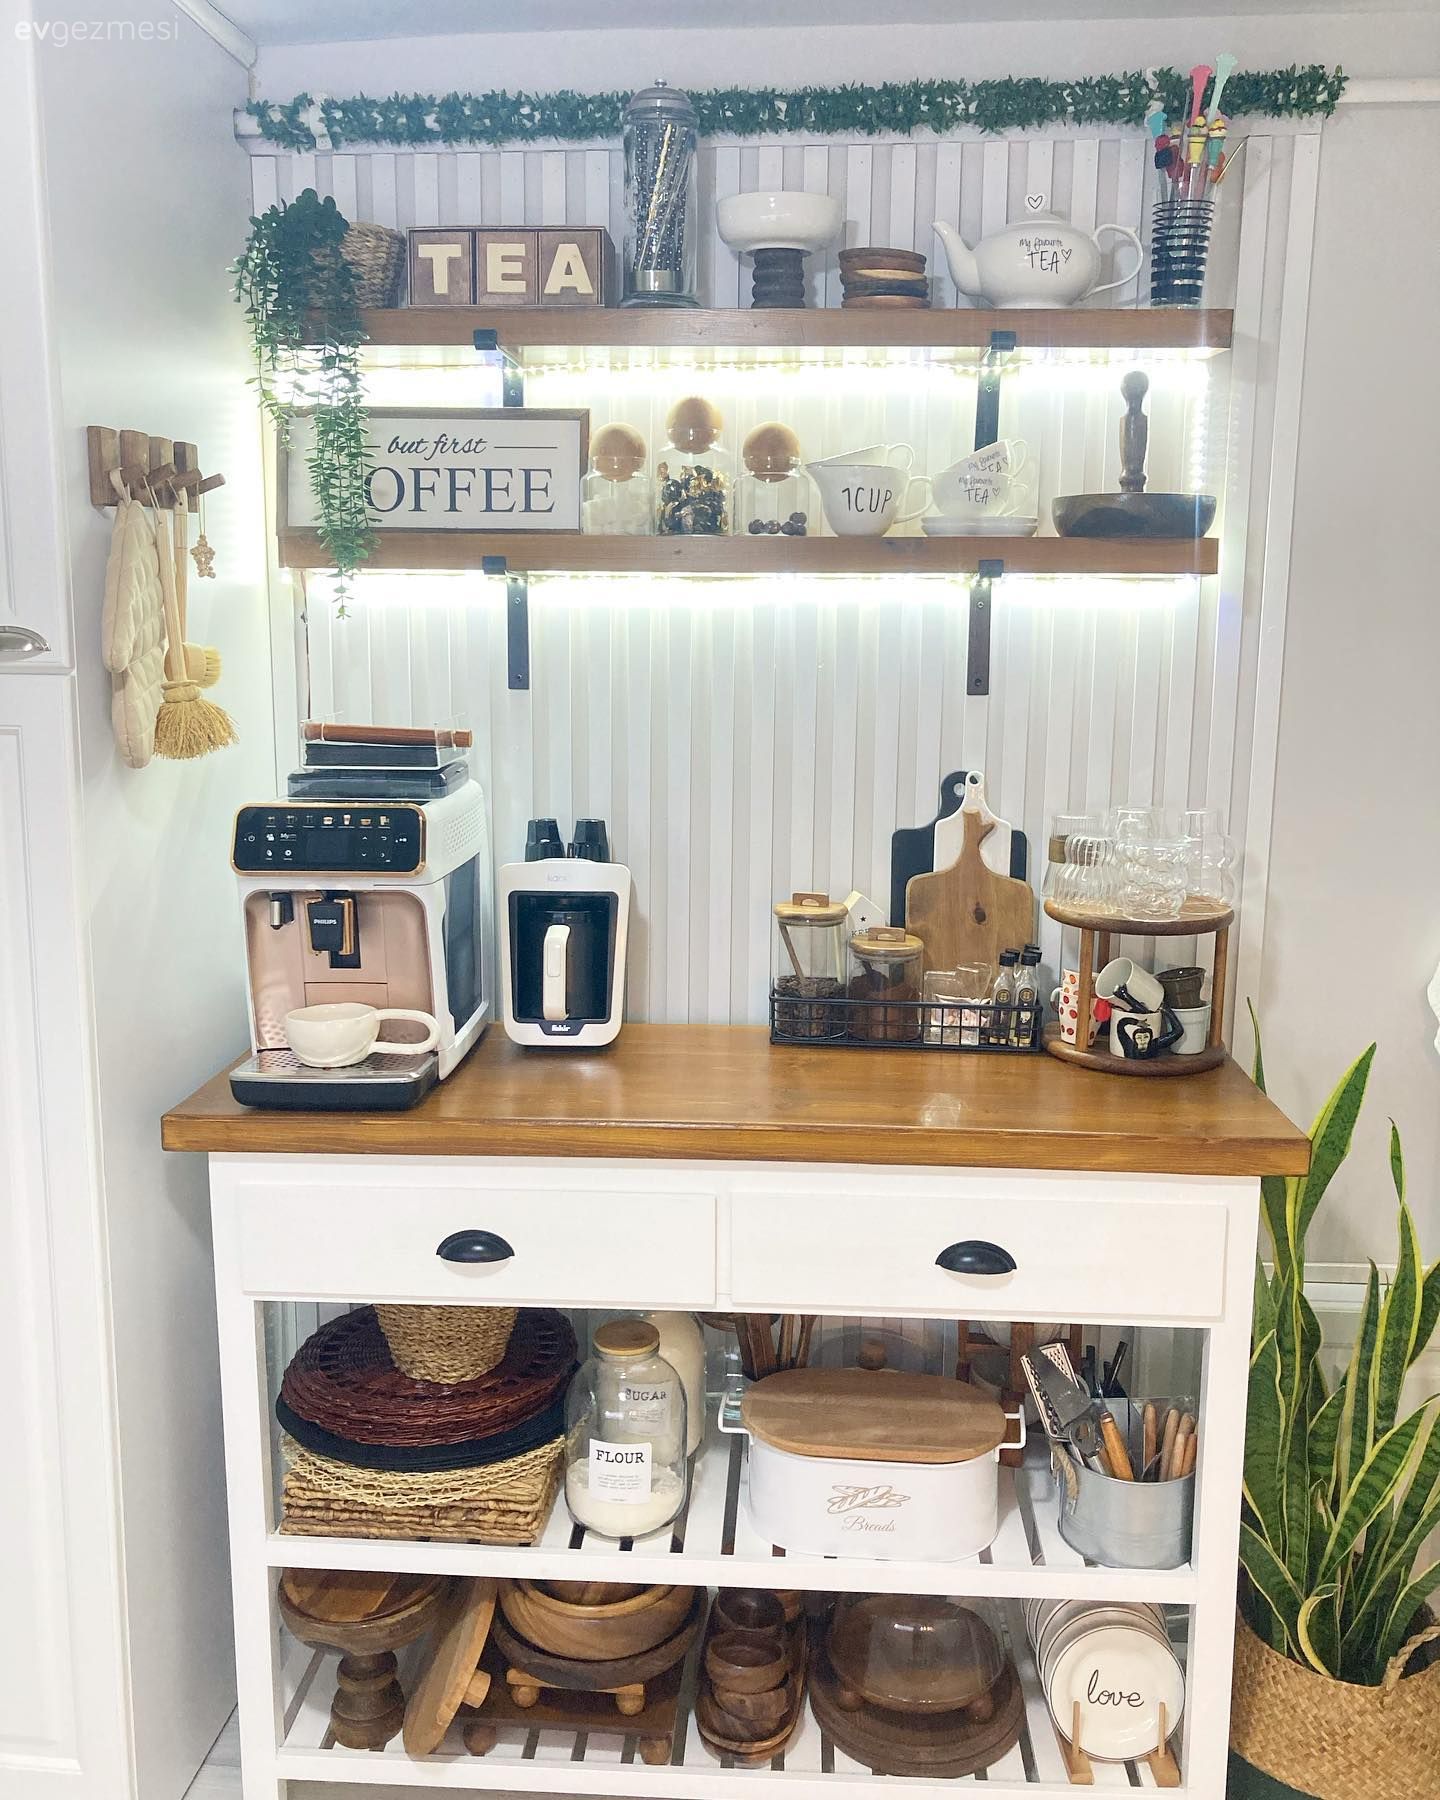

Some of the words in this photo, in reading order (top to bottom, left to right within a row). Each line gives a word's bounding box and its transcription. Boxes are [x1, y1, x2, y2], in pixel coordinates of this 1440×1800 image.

[418, 243, 593, 294] TEA
[1027, 250, 1060, 274] TEA
[387, 435, 428, 454] but
[423, 433, 488, 461] first
[356, 466, 554, 513] OFFEE
[963, 488, 990, 504] TEA
[625, 1387, 668, 1401] SUGAR
[595, 1449, 645, 1464] FLOUR
[842, 1515, 895, 1532] Breads
[1087, 1669, 1145, 1707] love
